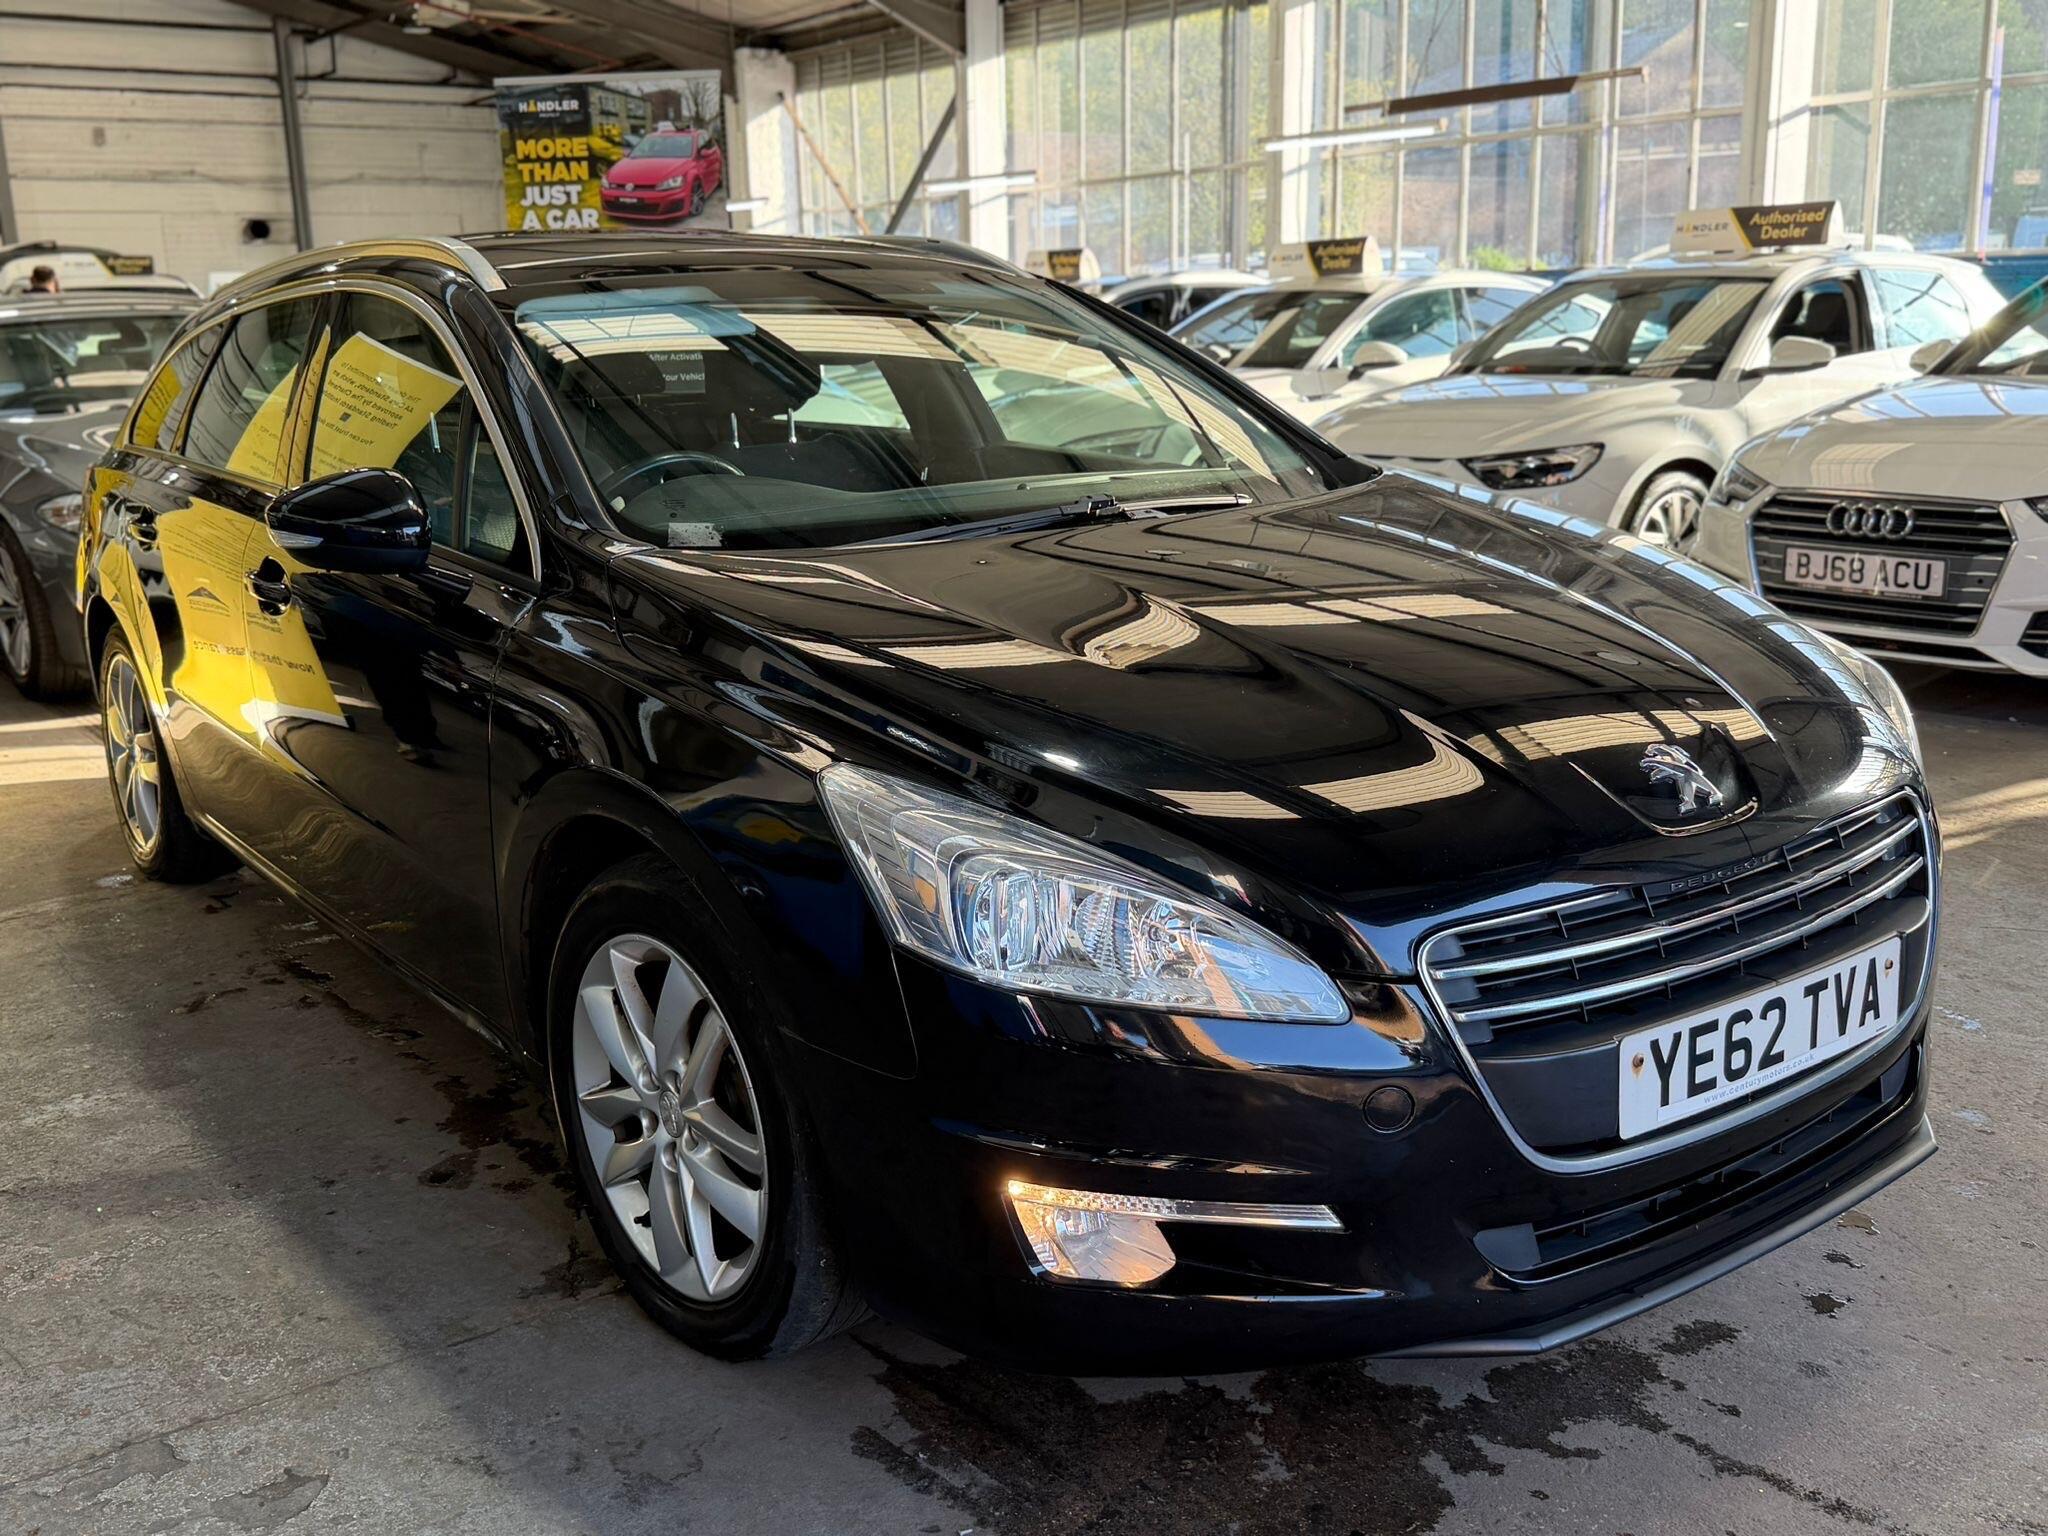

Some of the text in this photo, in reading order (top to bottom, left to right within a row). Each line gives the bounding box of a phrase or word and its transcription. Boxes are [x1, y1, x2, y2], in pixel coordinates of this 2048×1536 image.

[516, 137, 589, 160] MORE
[517, 160, 589, 182] THAN
[521, 184, 582, 206] JUST
[522, 207, 600, 231] A CAR
[1750, 208, 1827, 226] Authorised
[1761, 224, 1809, 240] Dealer
[1795, 552, 1932, 590] BJ68 ACU
[1650, 957, 1881, 1108] YE62 TVA
